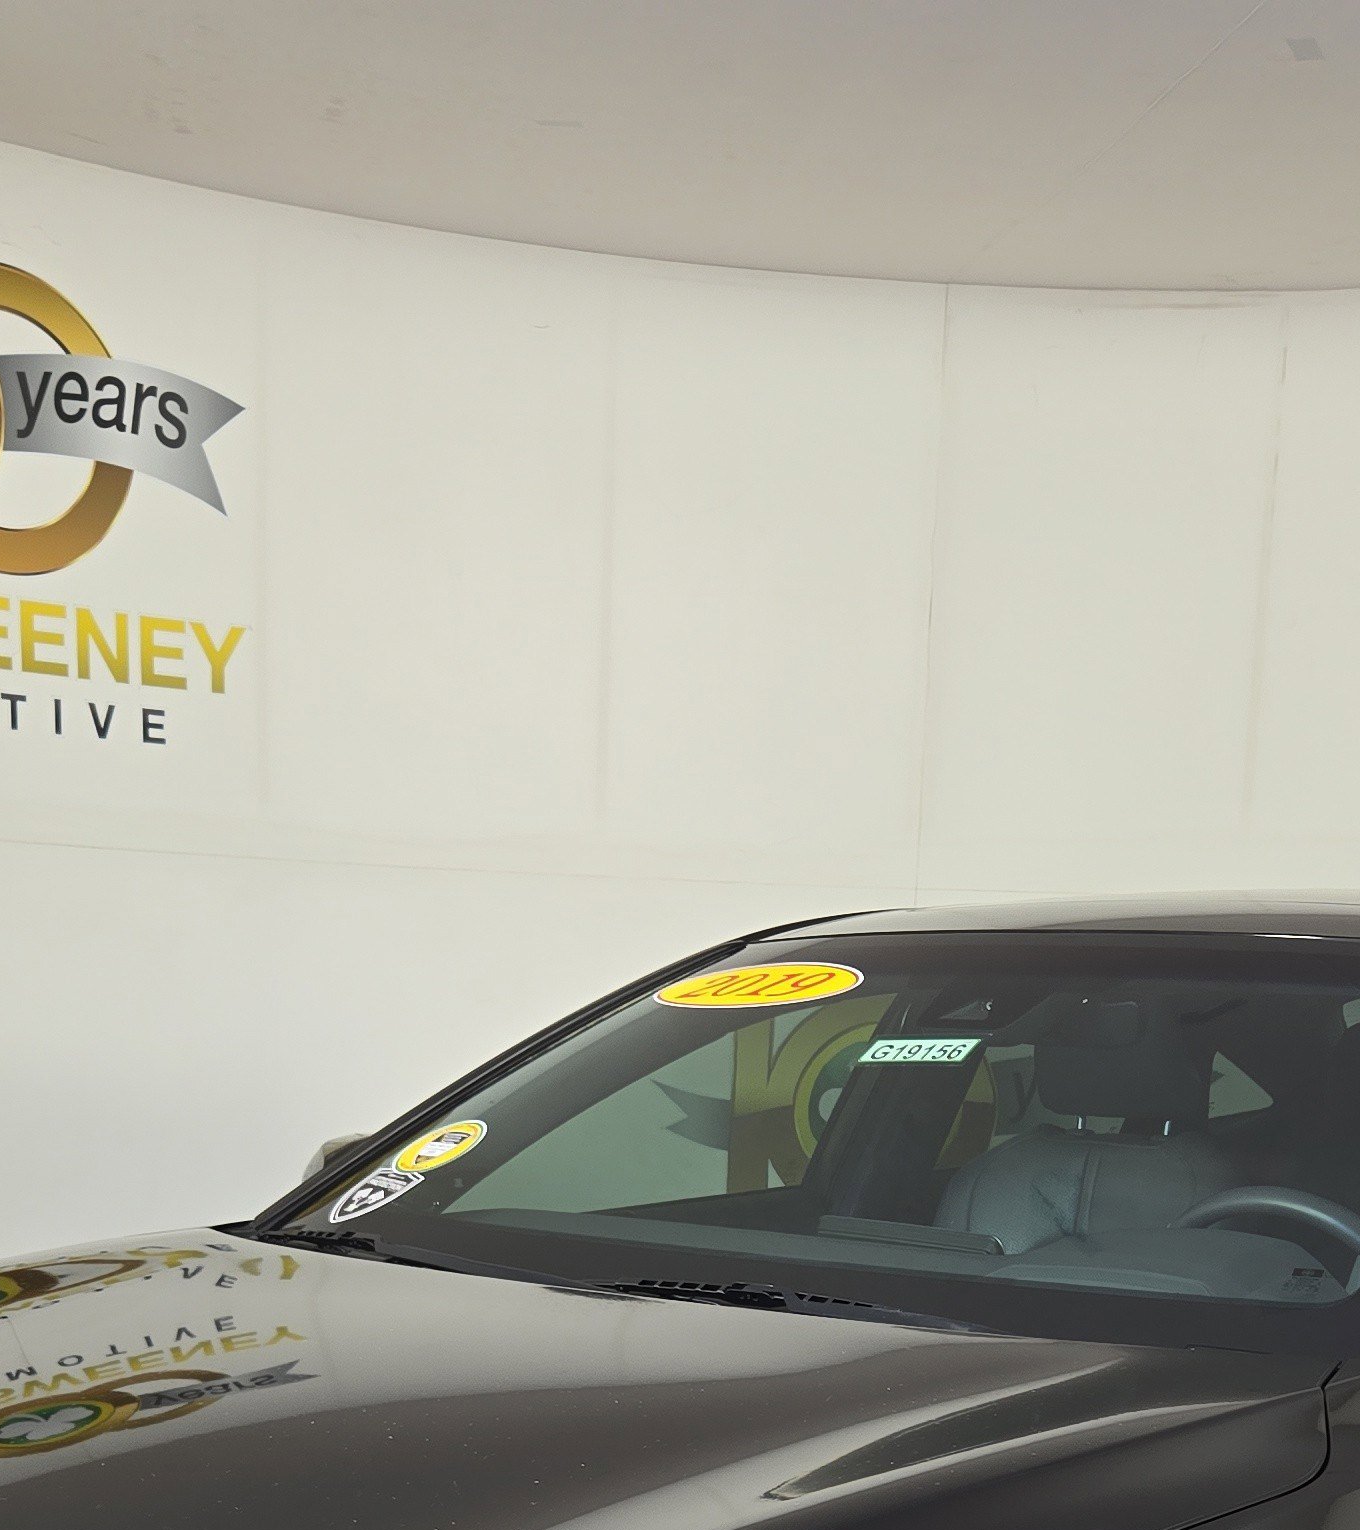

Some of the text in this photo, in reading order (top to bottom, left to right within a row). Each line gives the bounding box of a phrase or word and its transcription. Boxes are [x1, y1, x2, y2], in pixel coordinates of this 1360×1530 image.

[15, 368, 190, 450] years
[676, 971, 837, 998] 2019
[870, 1043, 969, 1061] G19156
